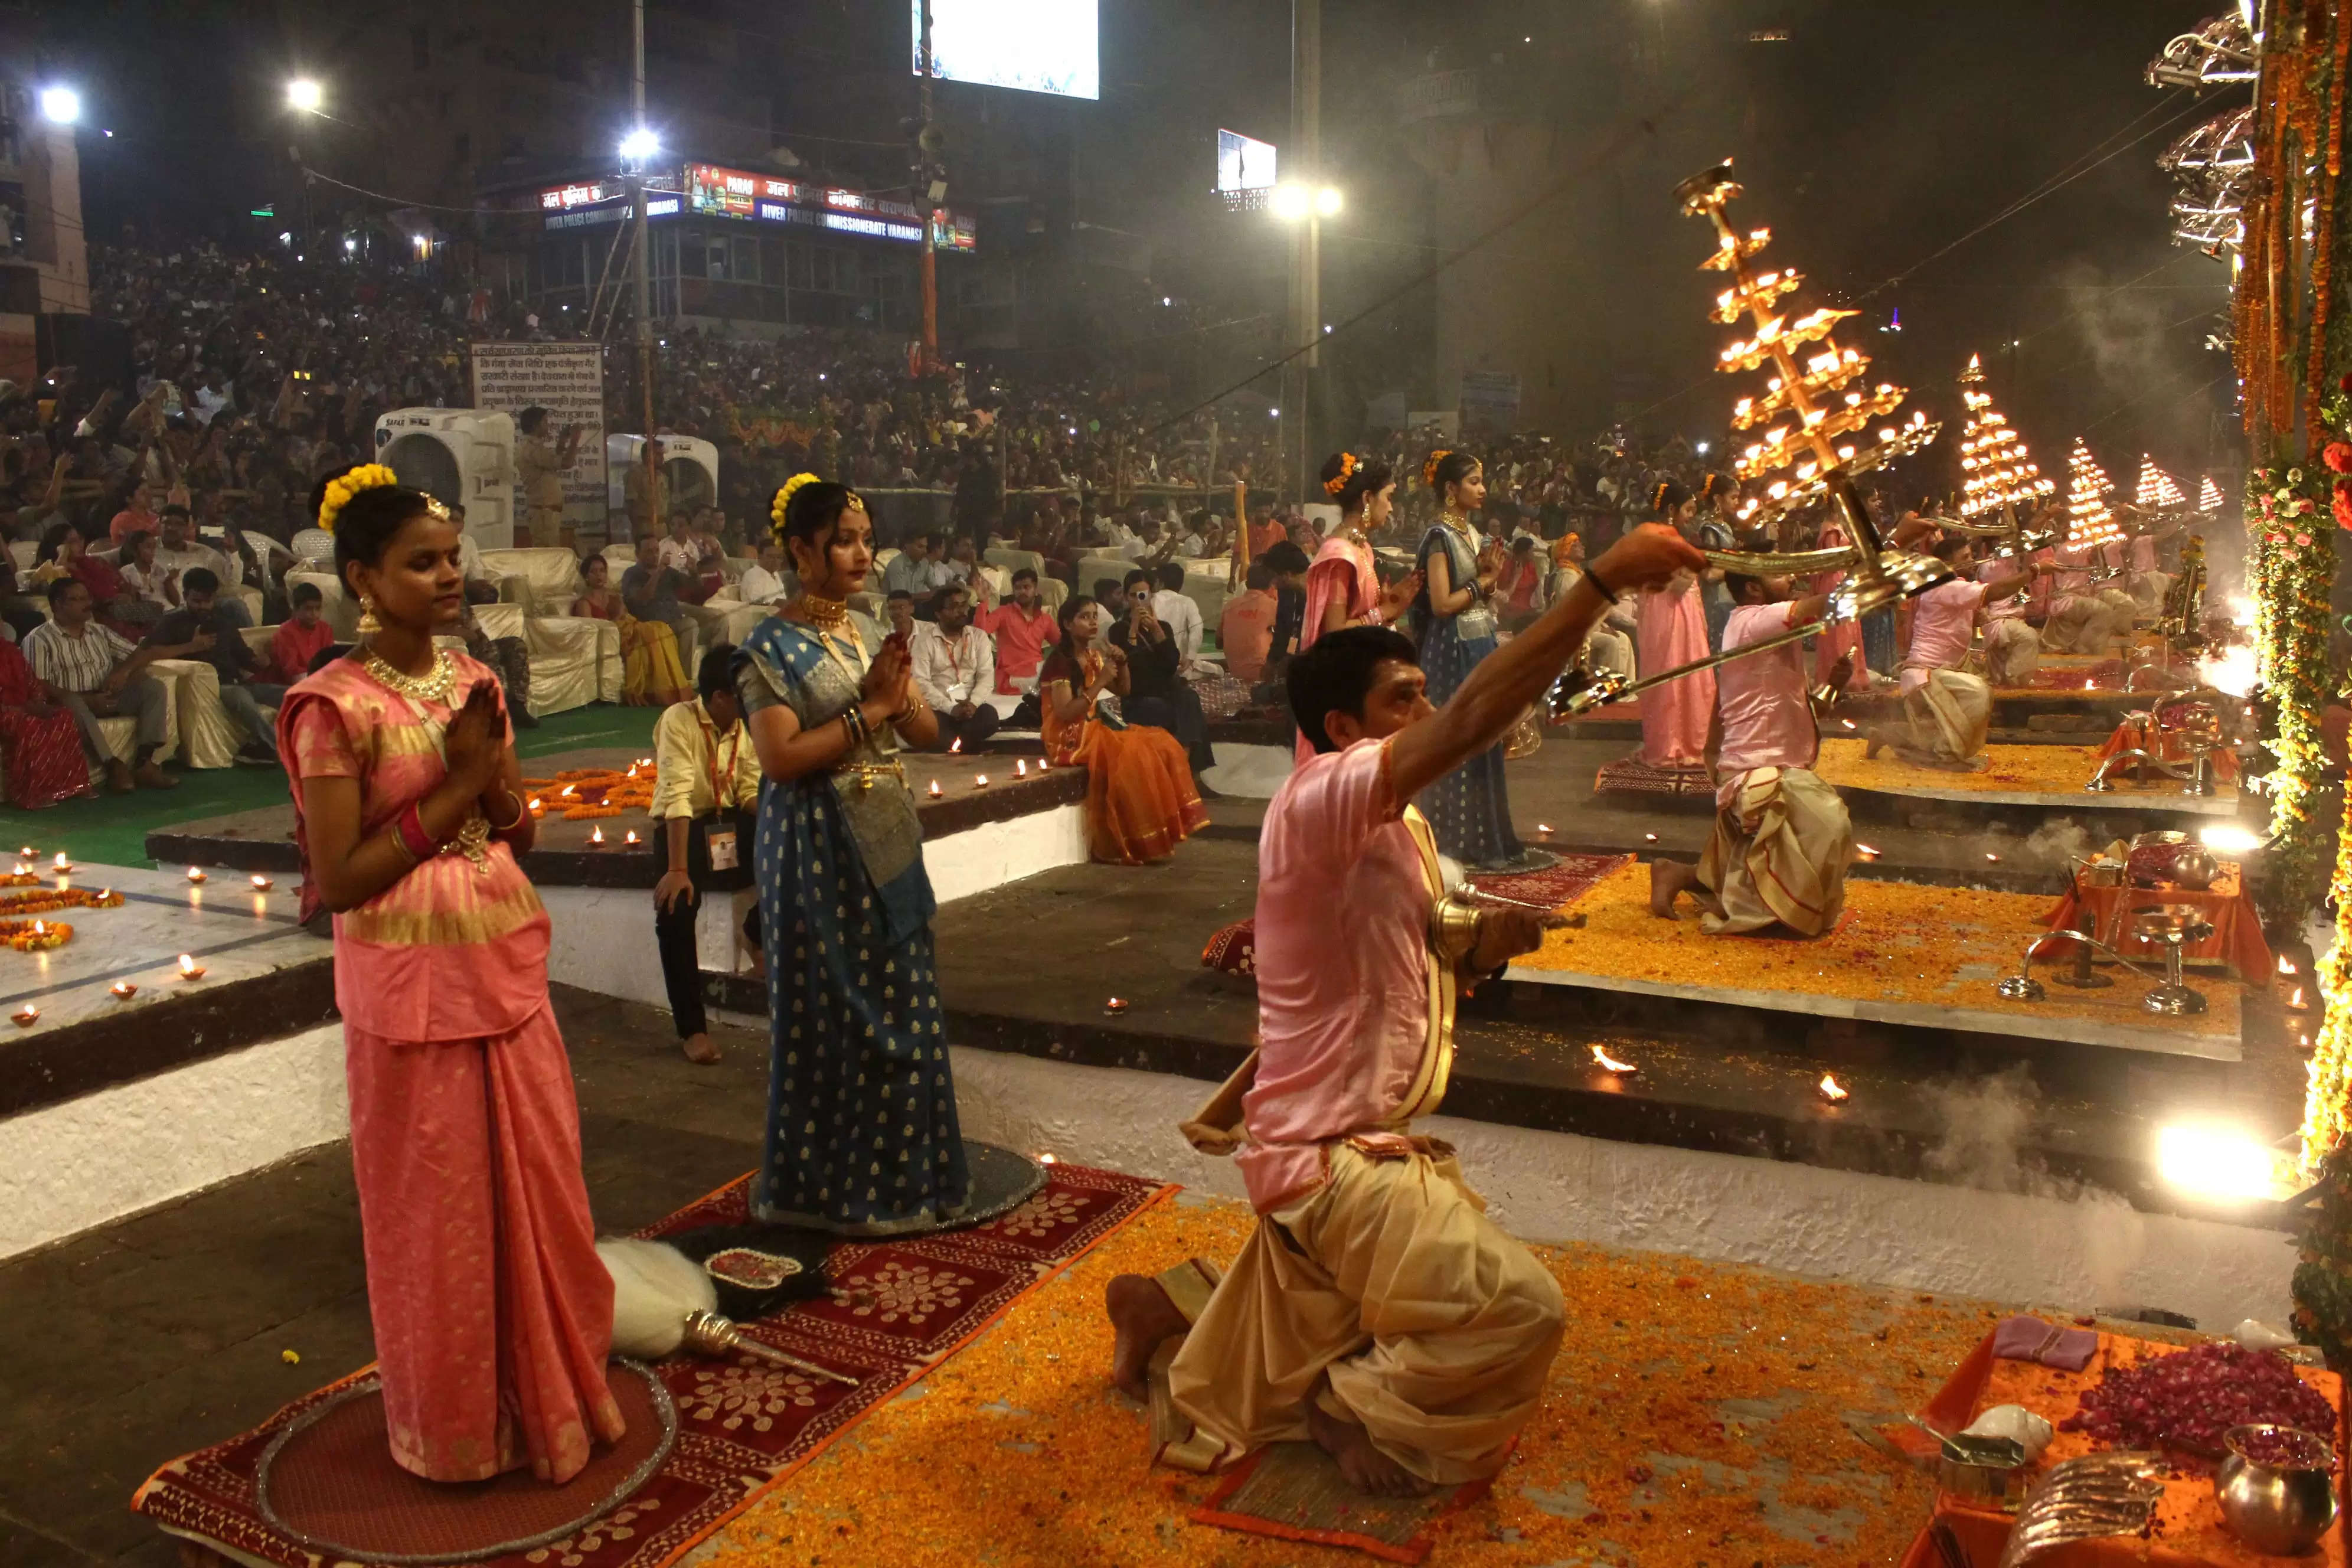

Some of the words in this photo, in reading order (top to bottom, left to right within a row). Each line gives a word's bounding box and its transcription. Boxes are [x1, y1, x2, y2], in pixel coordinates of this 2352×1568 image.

[766, 180, 789, 197] जल
[564, 212, 585, 227] POLICE
[762, 204, 786, 221] RIVER
[787, 208, 814, 226] POLICE
[815, 212, 886, 237] COMMISSIONERATE
[887, 223, 922, 241] VARANASI
